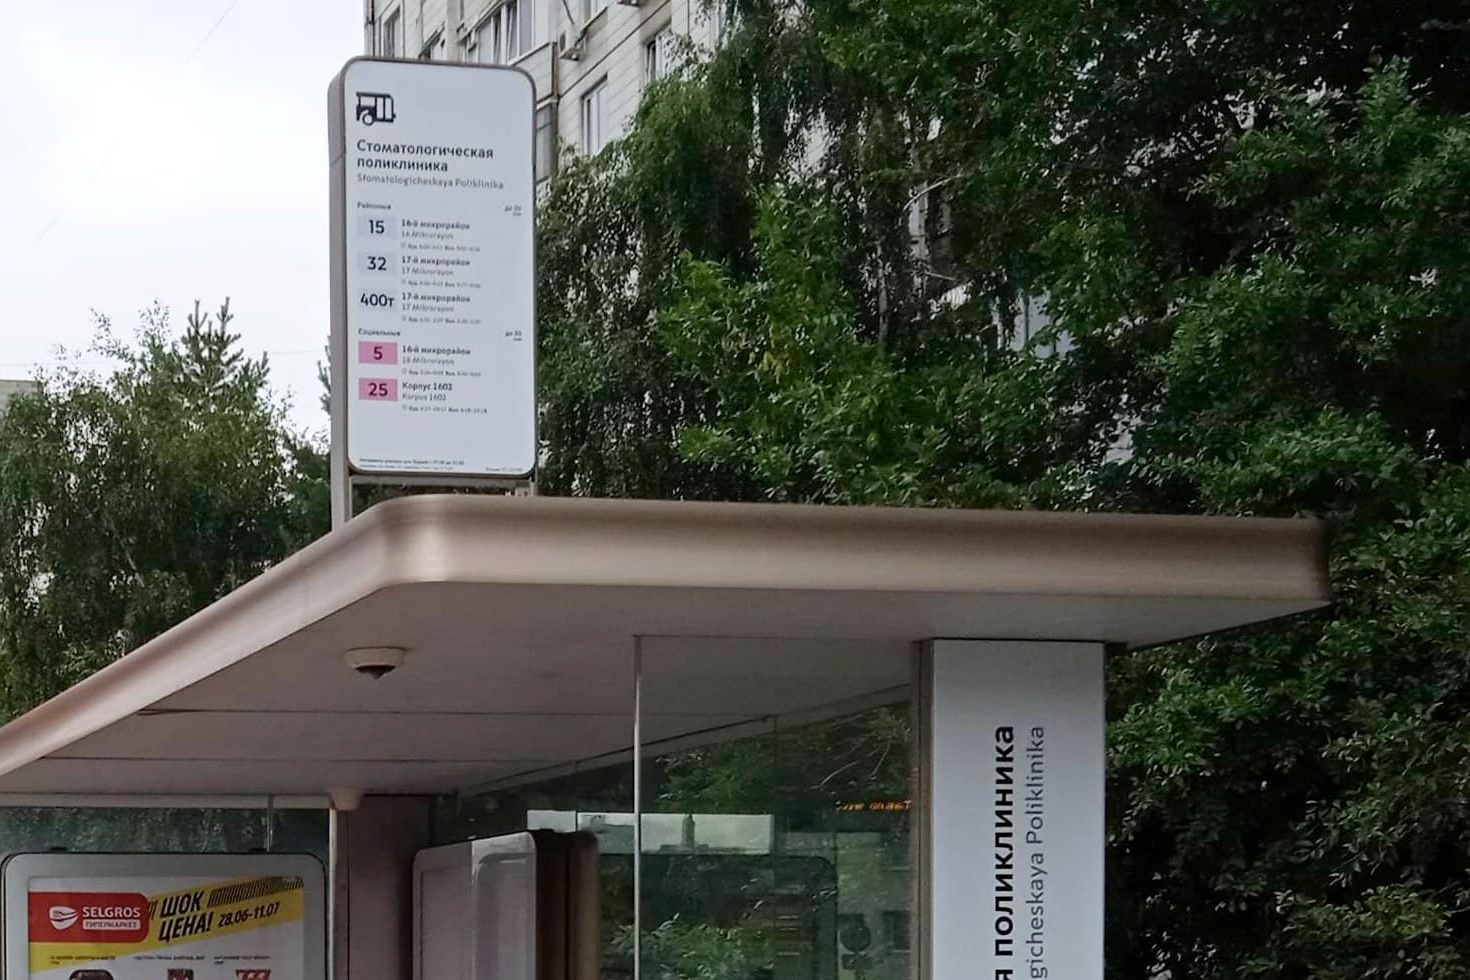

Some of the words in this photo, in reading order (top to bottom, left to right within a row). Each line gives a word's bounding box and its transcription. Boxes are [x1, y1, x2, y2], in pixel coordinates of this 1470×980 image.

[357, 139, 494, 159] Стоматологическая
[357, 158, 448, 172] поликлиника
[357, 173, 453, 188] Stomatologicheskaya
[455, 178, 504, 189] Poliklinika
[369, 219, 385, 234] 15
[420, 221, 470, 230] микрорайон
[367, 256, 387, 271] 32
[402, 256, 418, 264] 17-й
[420, 257, 470, 267] микрорайон
[360, 293, 395, 307] 400т
[402, 292, 418, 301] 17-й
[420, 293, 470, 303] микрорайон
[373, 346, 383, 360] 5
[402, 345, 419, 353] 16-й
[421, 347, 471, 356] микрорайон
[368, 383, 388, 397] 25
[402, 382, 432, 392] Корпус
[402, 393, 427, 402] Korpus
[1025, 726, 1044, 844] Poliklinika
[994, 726, 1013, 956] поликлиника
[160, 891, 204, 918] ШОК
[82, 906, 140, 918] SELGROS
[218, 902, 280, 928] 28.06-11.07
[158, 911, 214, 943] ЦЕНА!
